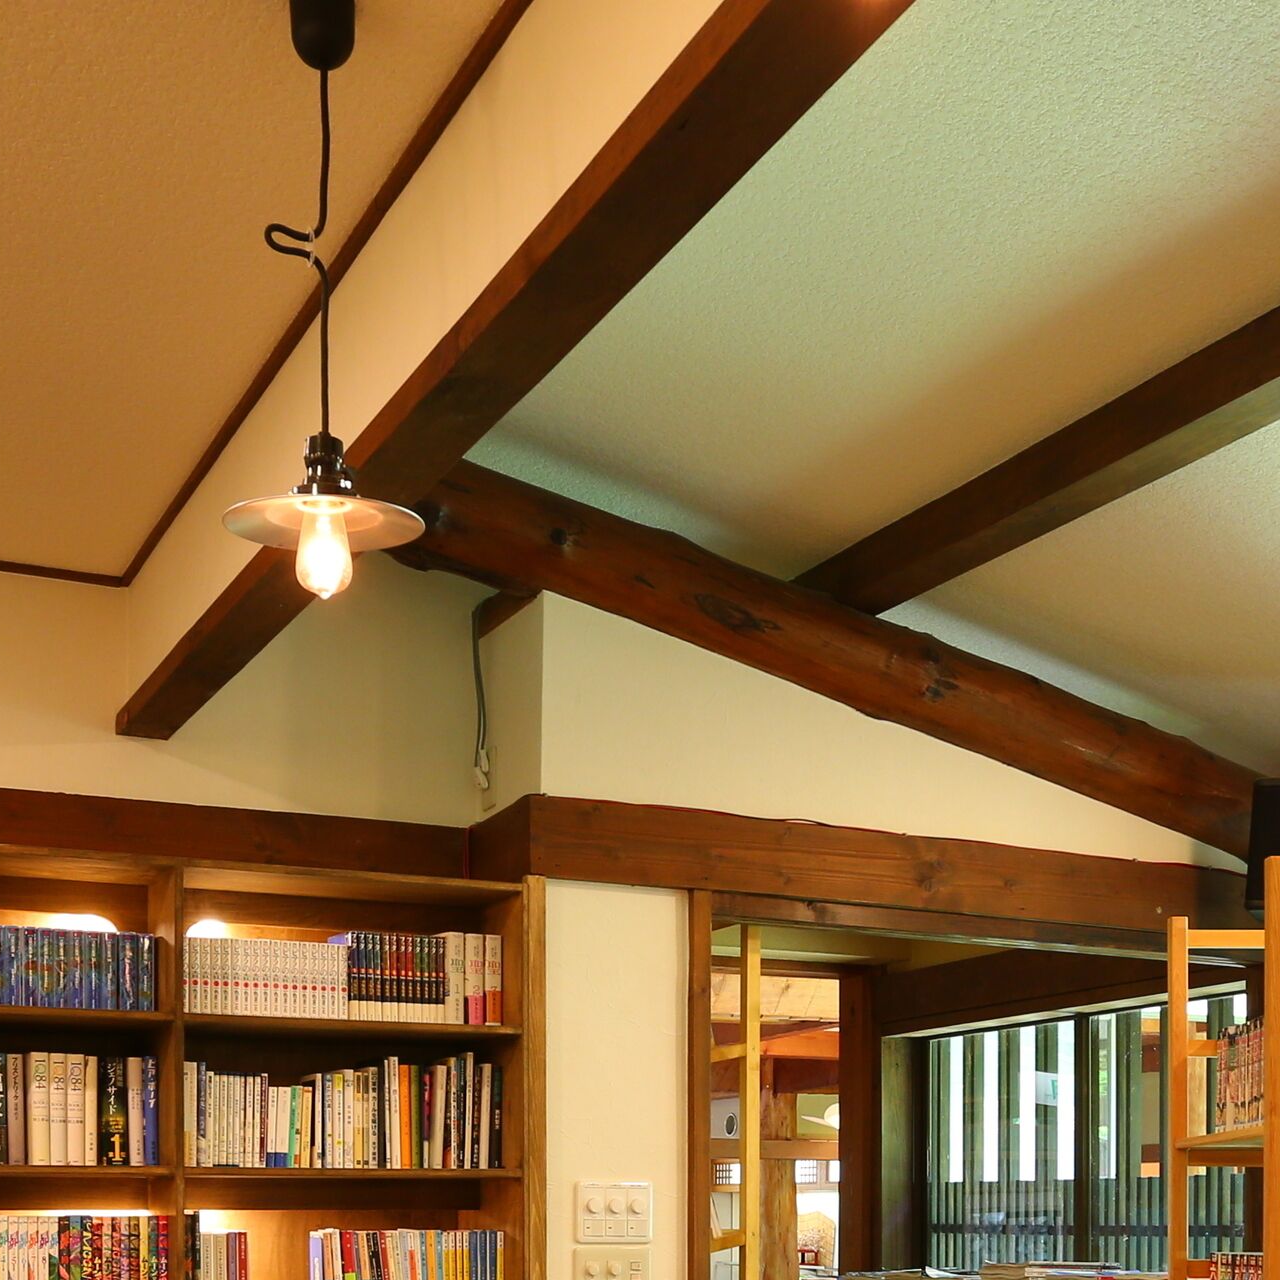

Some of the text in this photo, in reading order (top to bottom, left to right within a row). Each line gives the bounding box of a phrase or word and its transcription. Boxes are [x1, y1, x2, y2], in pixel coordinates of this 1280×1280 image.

[35, 1060, 47, 1089] 1Q84
[53, 1061, 64, 1091] 1Q84
[70, 1062, 82, 1091] 1Q84
